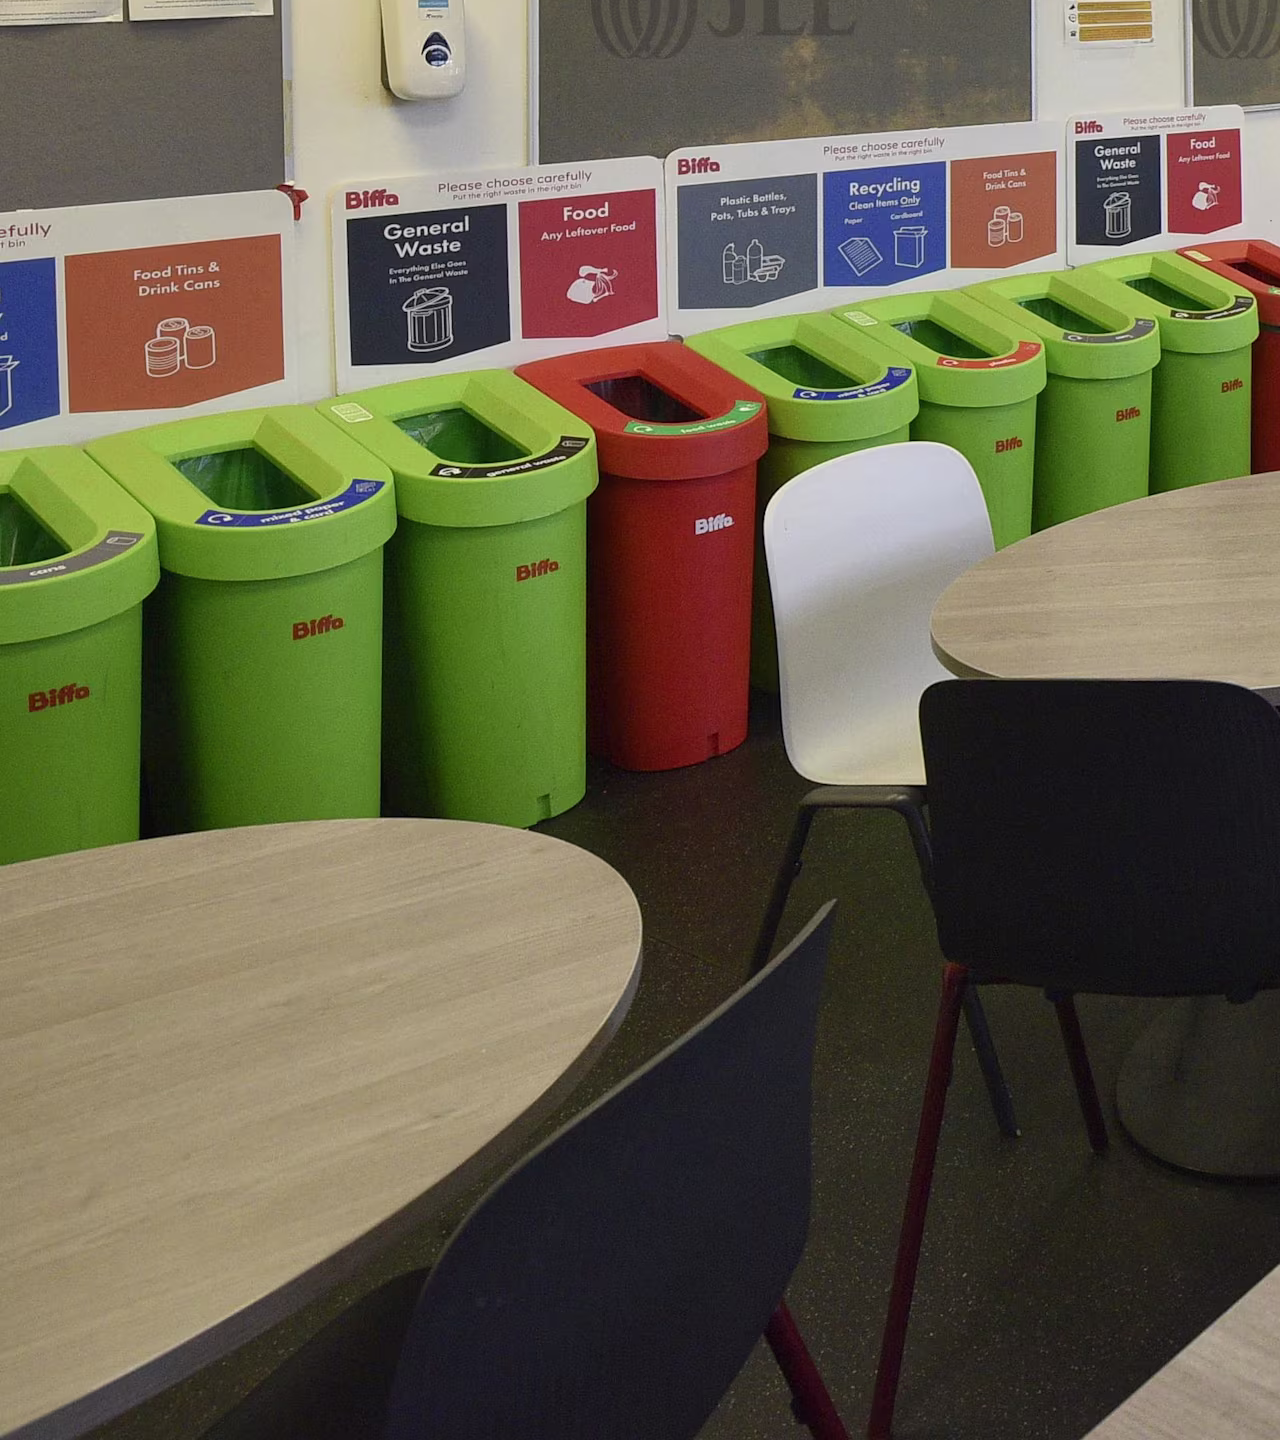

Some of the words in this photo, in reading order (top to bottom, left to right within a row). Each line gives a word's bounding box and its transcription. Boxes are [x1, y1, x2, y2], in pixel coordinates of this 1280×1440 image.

[1074, 120, 1103, 134] Biffa
[1123, 117, 1147, 126] Please
[1149, 115, 1175, 124] choose
[1176, 113, 1206, 122] carefully
[823, 144, 858, 156] Please
[861, 141, 898, 153] choose
[901, 137, 945, 150] carefully
[1094, 142, 1141, 157] General
[1190, 136, 1215, 150] Food
[858, 152, 872, 161] right
[872, 151, 890, 159] waste
[910, 148, 923, 157] right
[1178, 156, 1190, 164] Any
[1192, 154, 1215, 162] Leftover
[1215, 151, 1230, 160] Food
[678, 156, 721, 176] Biffa
[1100, 158, 1137, 170] Waste
[438, 181, 482, 193] Please
[486, 176, 533, 189] choose
[537, 170, 592, 185] carefully
[983, 168, 1003, 180] Food
[1003, 168, 1019, 178] Tins
[1019, 168, 1027, 176] &
[452, 193, 466, 201] Put
[467, 192, 480, 200] the
[482, 190, 499, 200] right
[500, 188, 525, 196] waste
[537, 185, 549, 193] the
[551, 183, 569, 193] right
[570, 182, 582, 190] bin
[849, 177, 921, 197] Recycling
[985, 180, 1006, 192] Drink
[1007, 179, 1027, 189] Cans
[345, 188, 400, 210] Biffa
[720, 194, 750, 207] Plastic
[753, 192, 787, 204] Bottles,
[849, 200, 874, 211] Clean
[875, 198, 899, 209] Items
[900, 195, 921, 207] Only
[563, 202, 609, 221] Food
[711, 210, 734, 222] Pots,
[737, 207, 759, 219] Tubs
[760, 207, 769, 216] &
[770, 203, 796, 217] Trays
[844, 217, 863, 225] Paper
[890, 210, 923, 221] Cardboard
[383, 216, 470, 241] General
[541, 230, 563, 242] Any
[565, 225, 608, 238] Leftover
[611, 221, 636, 233] Food
[8, 239, 26, 248] bin
[394, 240, 462, 259] Waste
[133, 265, 171, 281] Food
[175, 263, 204, 277] Tins
[208, 262, 220, 273] &
[389, 263, 430, 275] Everything
[431, 261, 446, 270] Else
[447, 259, 467, 269] Goes
[389, 277, 397, 285] In
[398, 275, 412, 284] The
[413, 271, 444, 282] General
[445, 268, 469, 279] Waste
[138, 282, 179, 297] Drink
[184, 278, 220, 292] Cans
[1221, 378, 1243, 393] Biffa
[1116, 406, 1140, 422] Biffa
[706, 418, 737, 429] waste
[995, 436, 1022, 453] Biffa
[486, 461, 532, 478] general
[533, 453, 567, 467] waste
[260, 510, 303, 524] mixed
[304, 500, 346, 518] paper
[289, 515, 301, 523] &
[304, 509, 335, 521] card
[694, 512, 735, 535] Biffa
[29, 563, 67, 577] cans
[516, 558, 560, 582] Biffa
[292, 614, 344, 641] Biffa
[28, 683, 90, 713] Biffa
